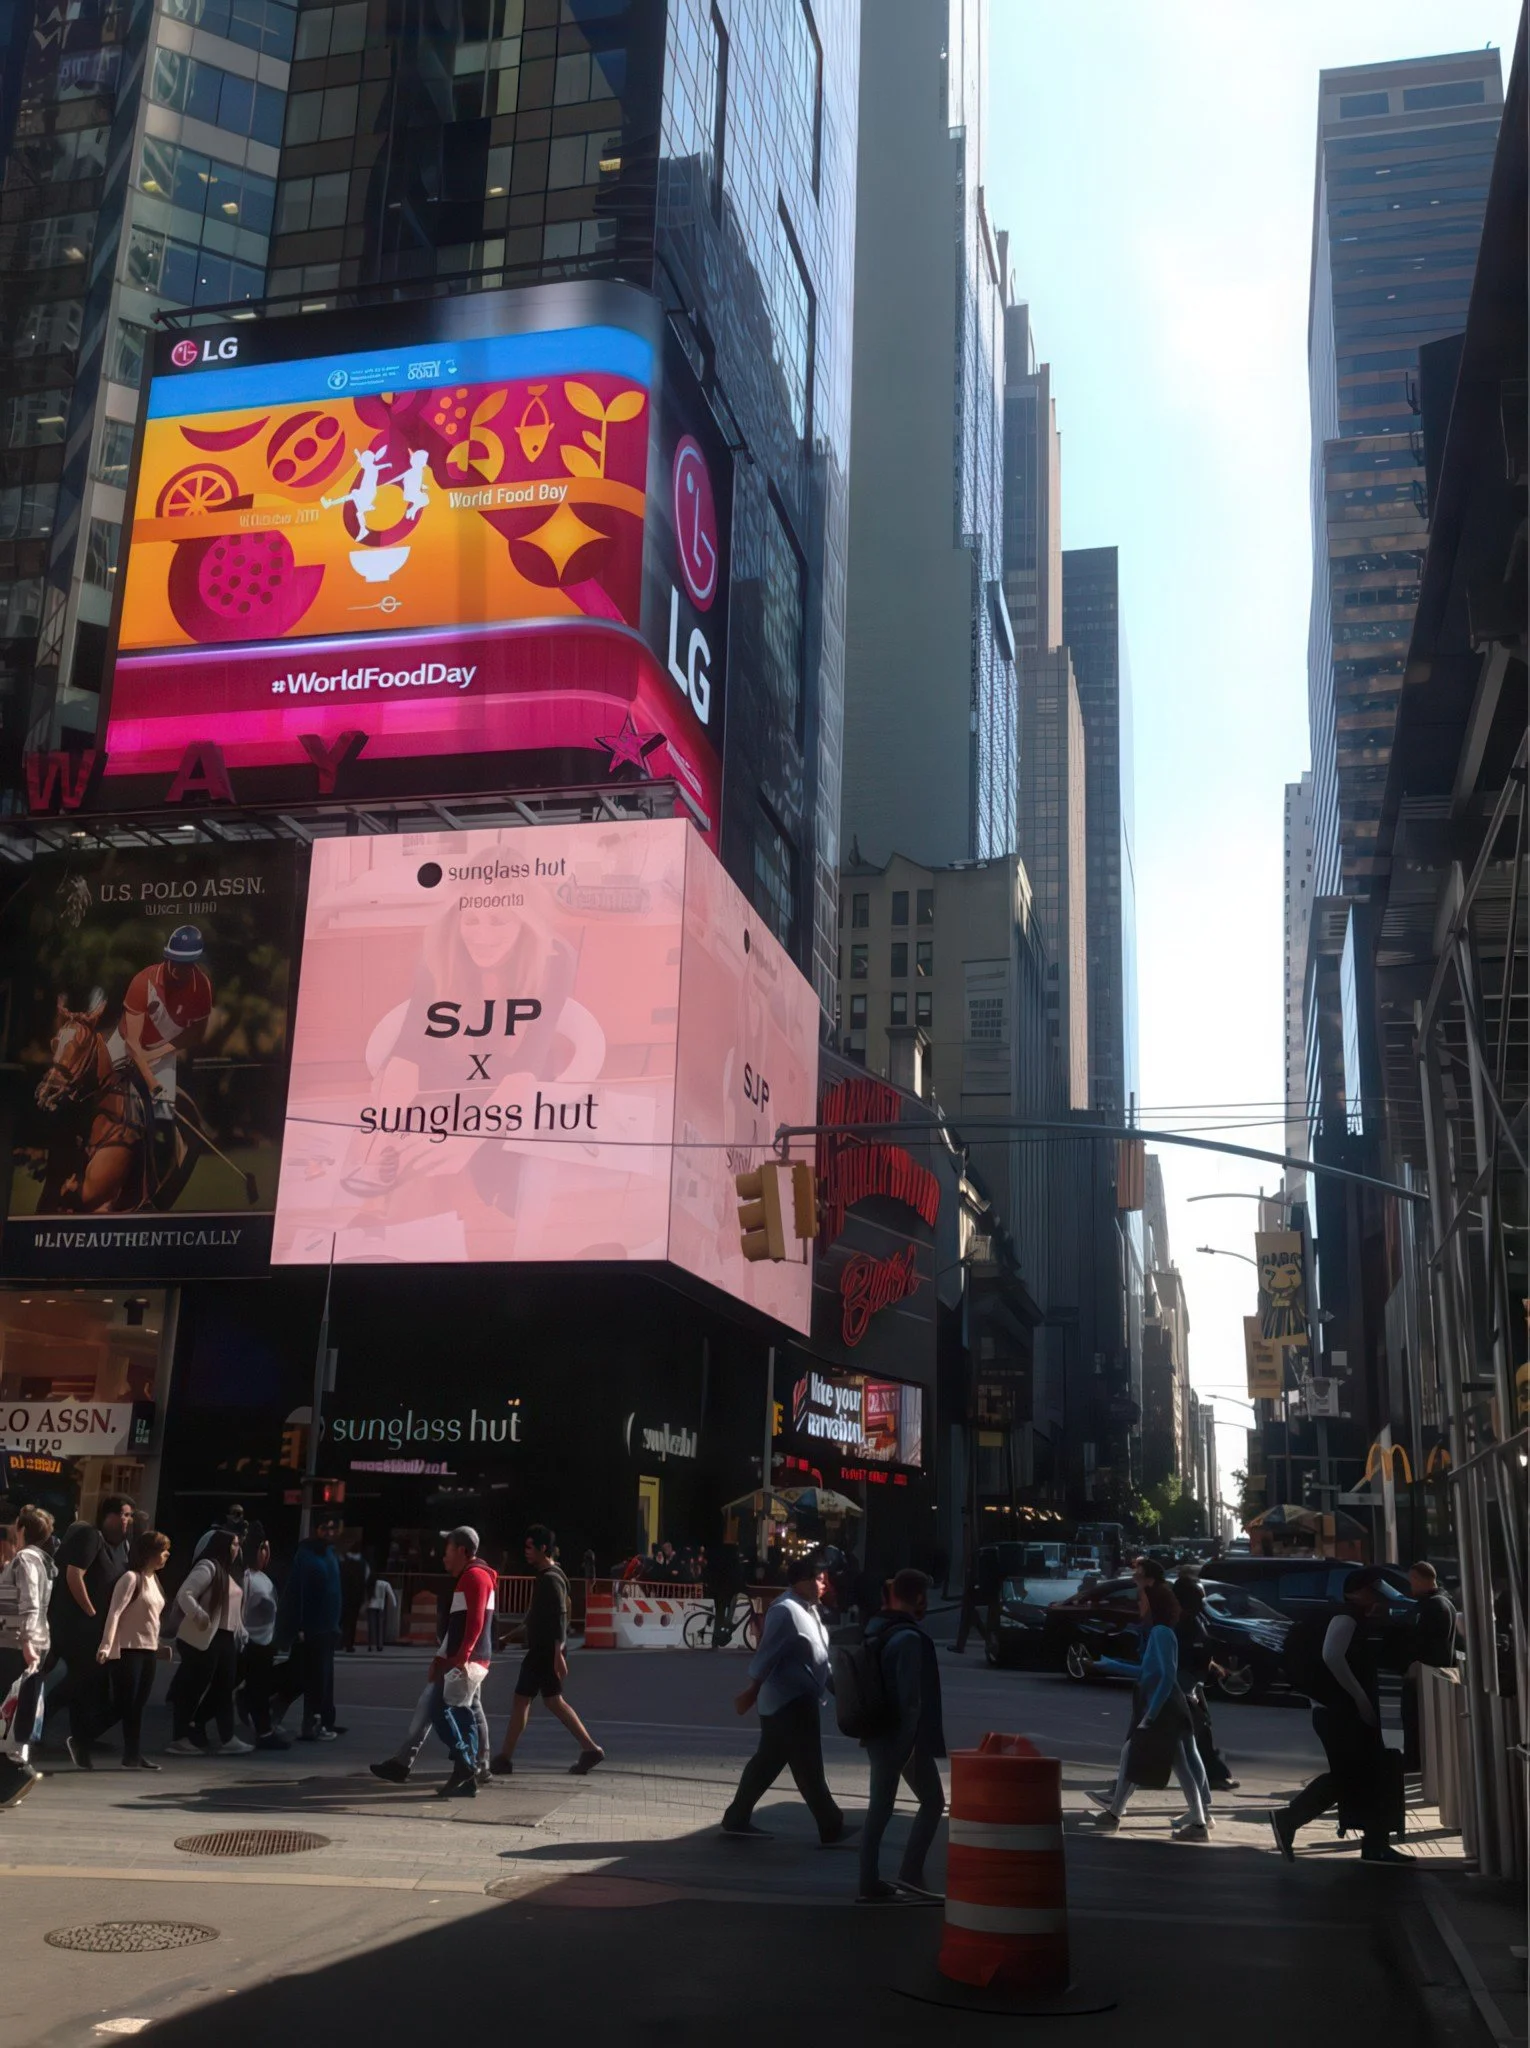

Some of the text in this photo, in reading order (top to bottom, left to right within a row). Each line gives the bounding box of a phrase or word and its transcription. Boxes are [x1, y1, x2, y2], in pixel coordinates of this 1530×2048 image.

[202, 337, 239, 361] LG
[449, 491, 492, 508] World
[496, 487, 538, 504] Food
[668, 585, 711, 725] LG
[271, 662, 477, 695] #WorldFoodDay
[448, 857, 567, 886] sunglass hut
[140, 880, 198, 901] POLO
[202, 876, 266, 898] ASSN.
[424, 998, 543, 1039] SJP
[743, 1061, 770, 1114] SJP
[359, 1091, 599, 1143] sunglass hut
[36, 1408, 117, 1434] ASSN.
[332, 1408, 522, 1451] sunglass hut
